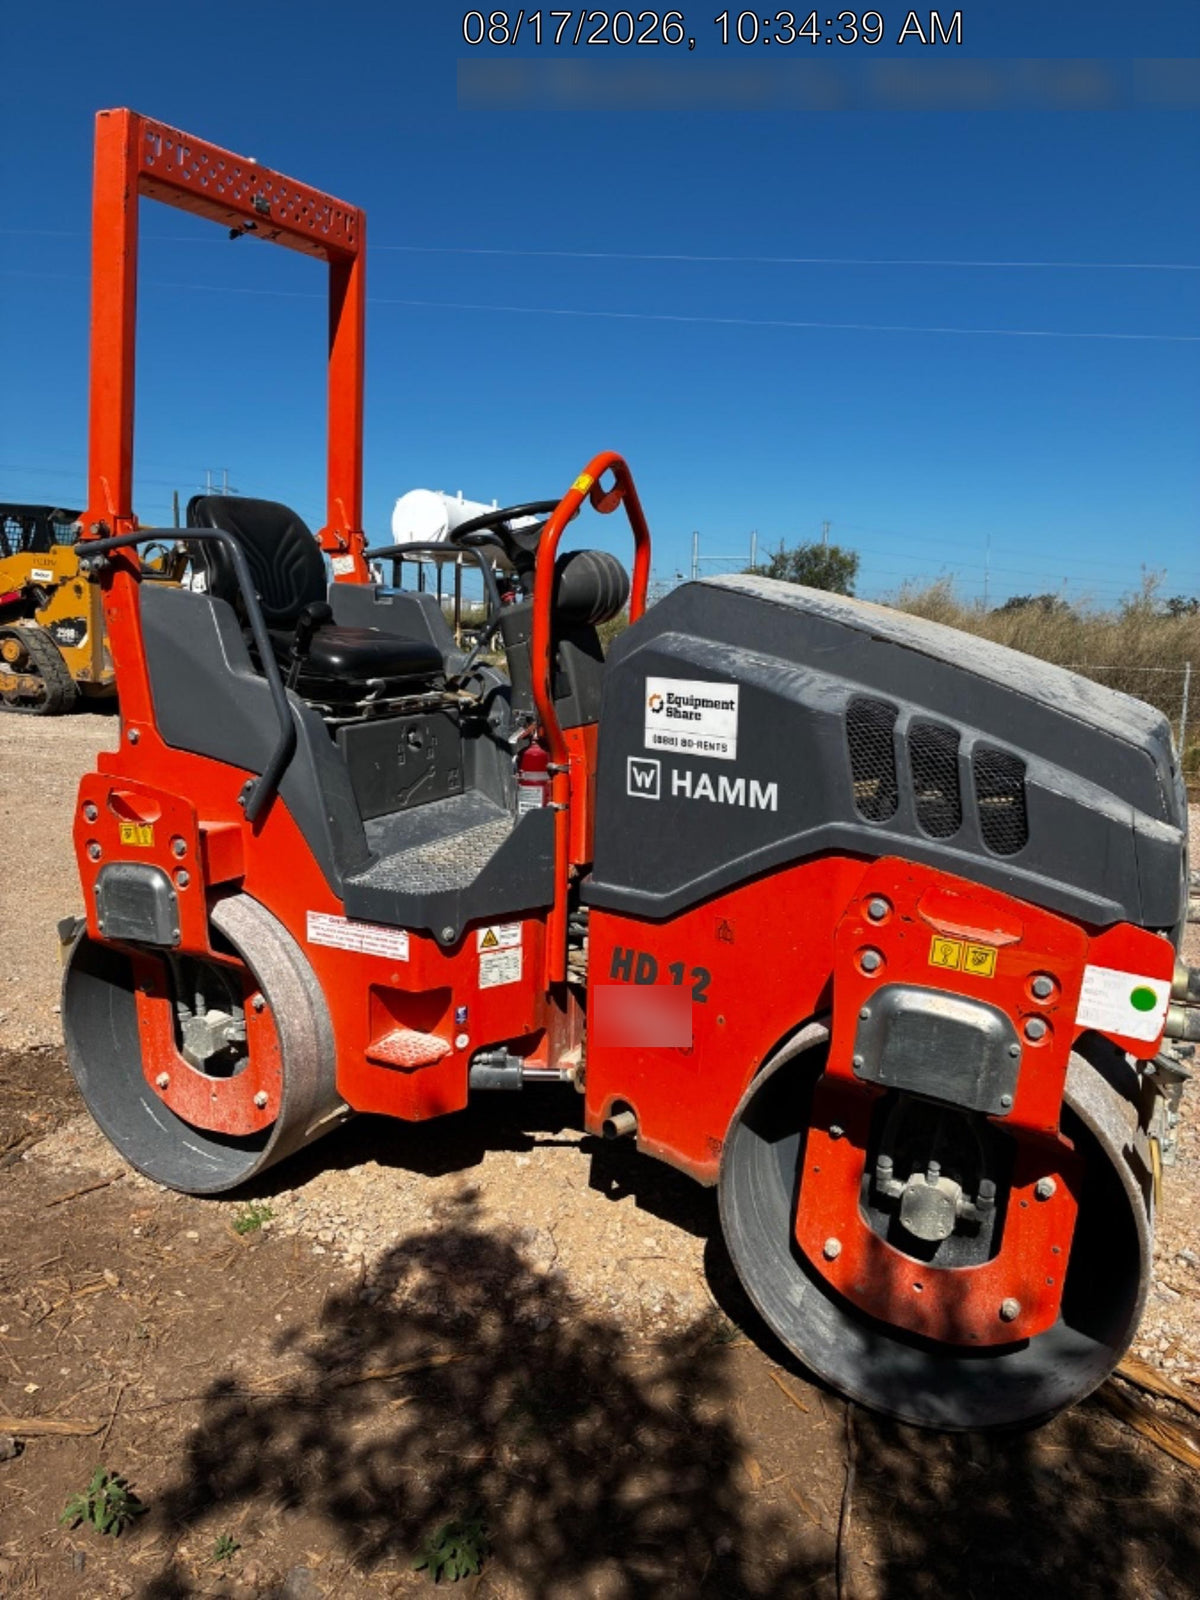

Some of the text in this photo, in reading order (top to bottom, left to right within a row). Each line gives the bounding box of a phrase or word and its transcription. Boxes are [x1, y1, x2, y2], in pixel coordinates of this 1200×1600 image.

[666, 692, 735, 711] Equipment
[666, 706, 702, 721] Share
[632, 766, 778, 812] W HAMM
[609, 945, 712, 1004] HD 12
